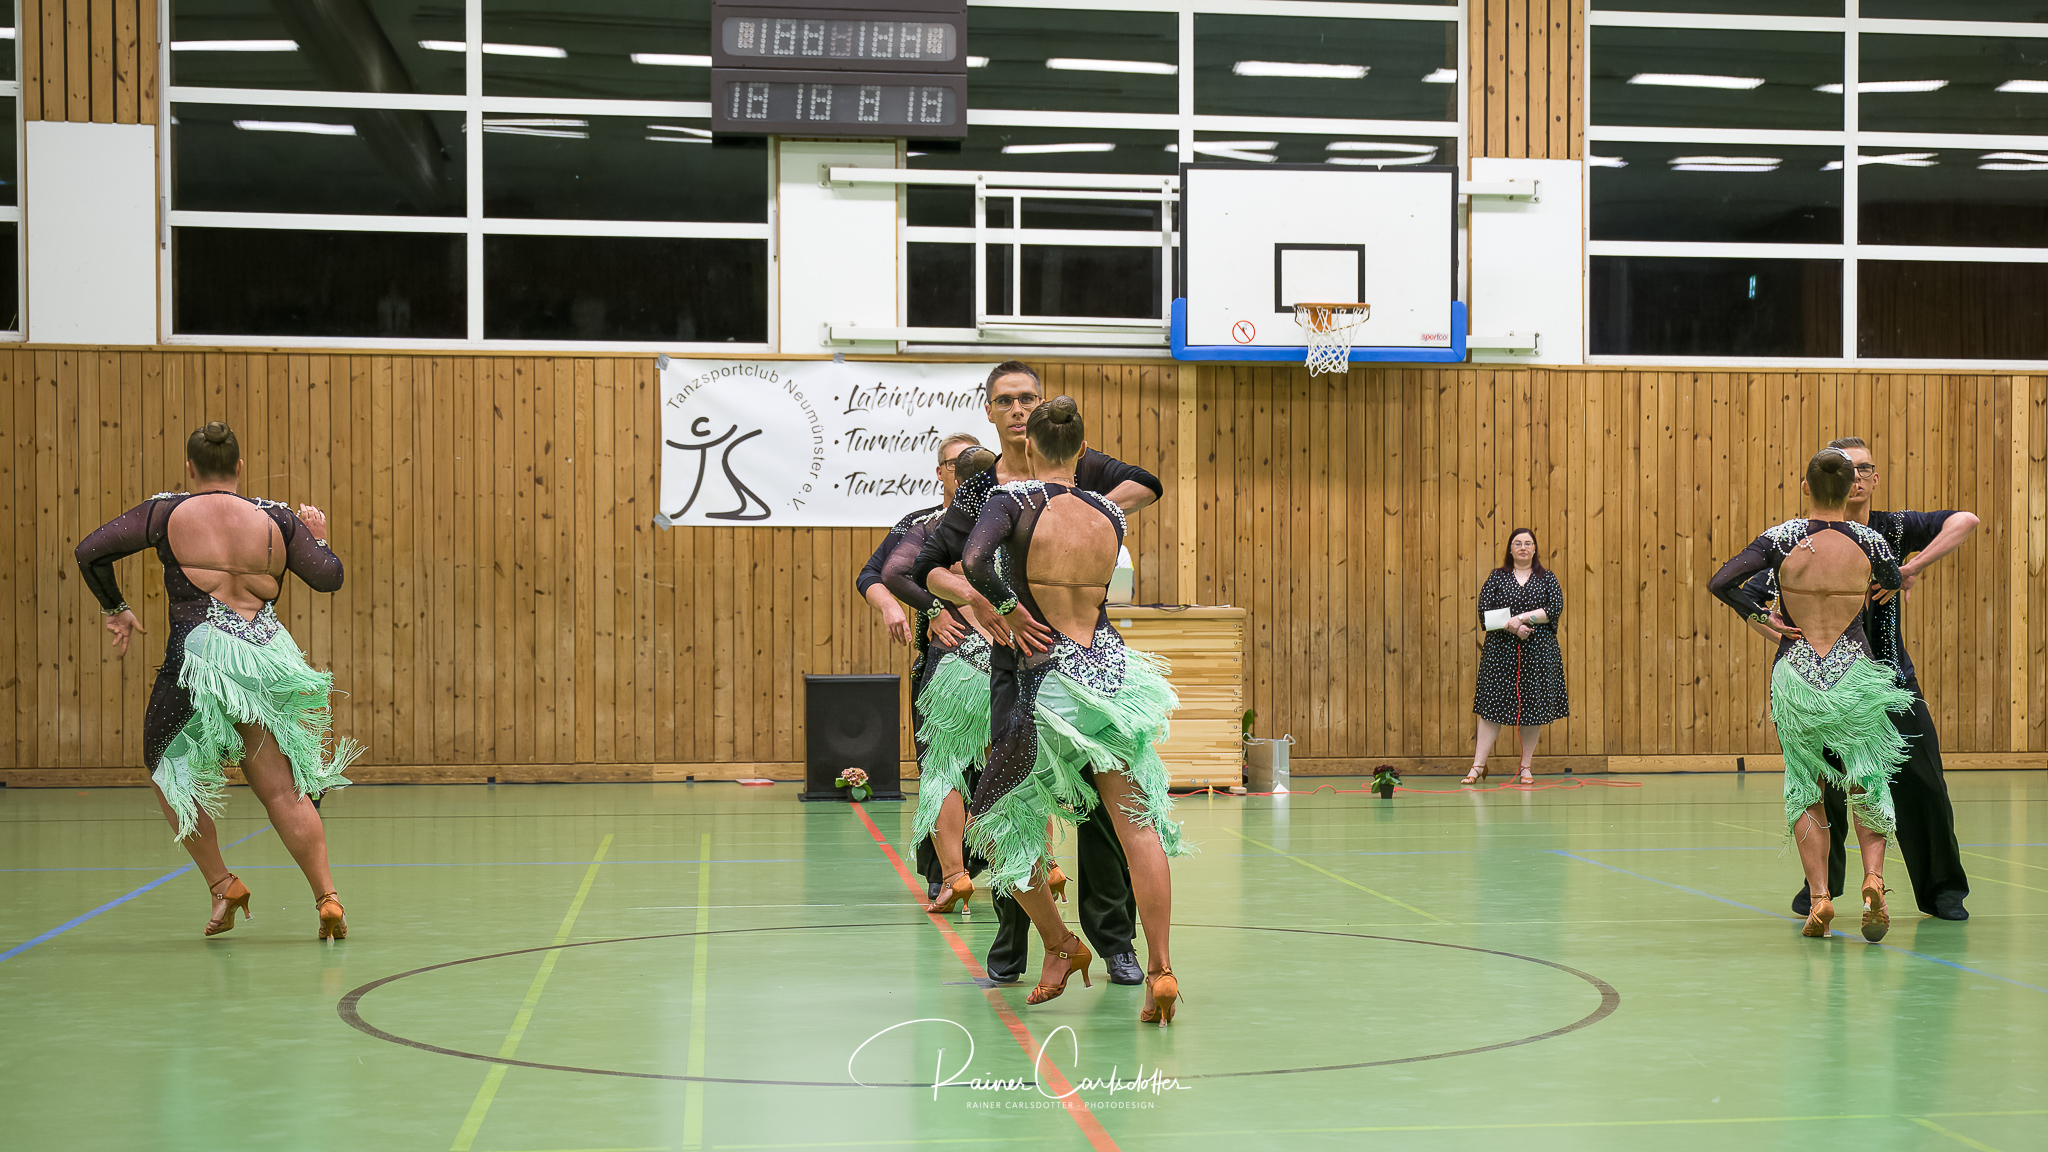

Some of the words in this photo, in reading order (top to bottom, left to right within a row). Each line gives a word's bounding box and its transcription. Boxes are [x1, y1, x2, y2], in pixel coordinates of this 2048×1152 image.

[666, 363, 779, 410] Tanzsportclub
[783, 379, 825, 480] Neumünster
[787, 483, 812, 511] e.V.
